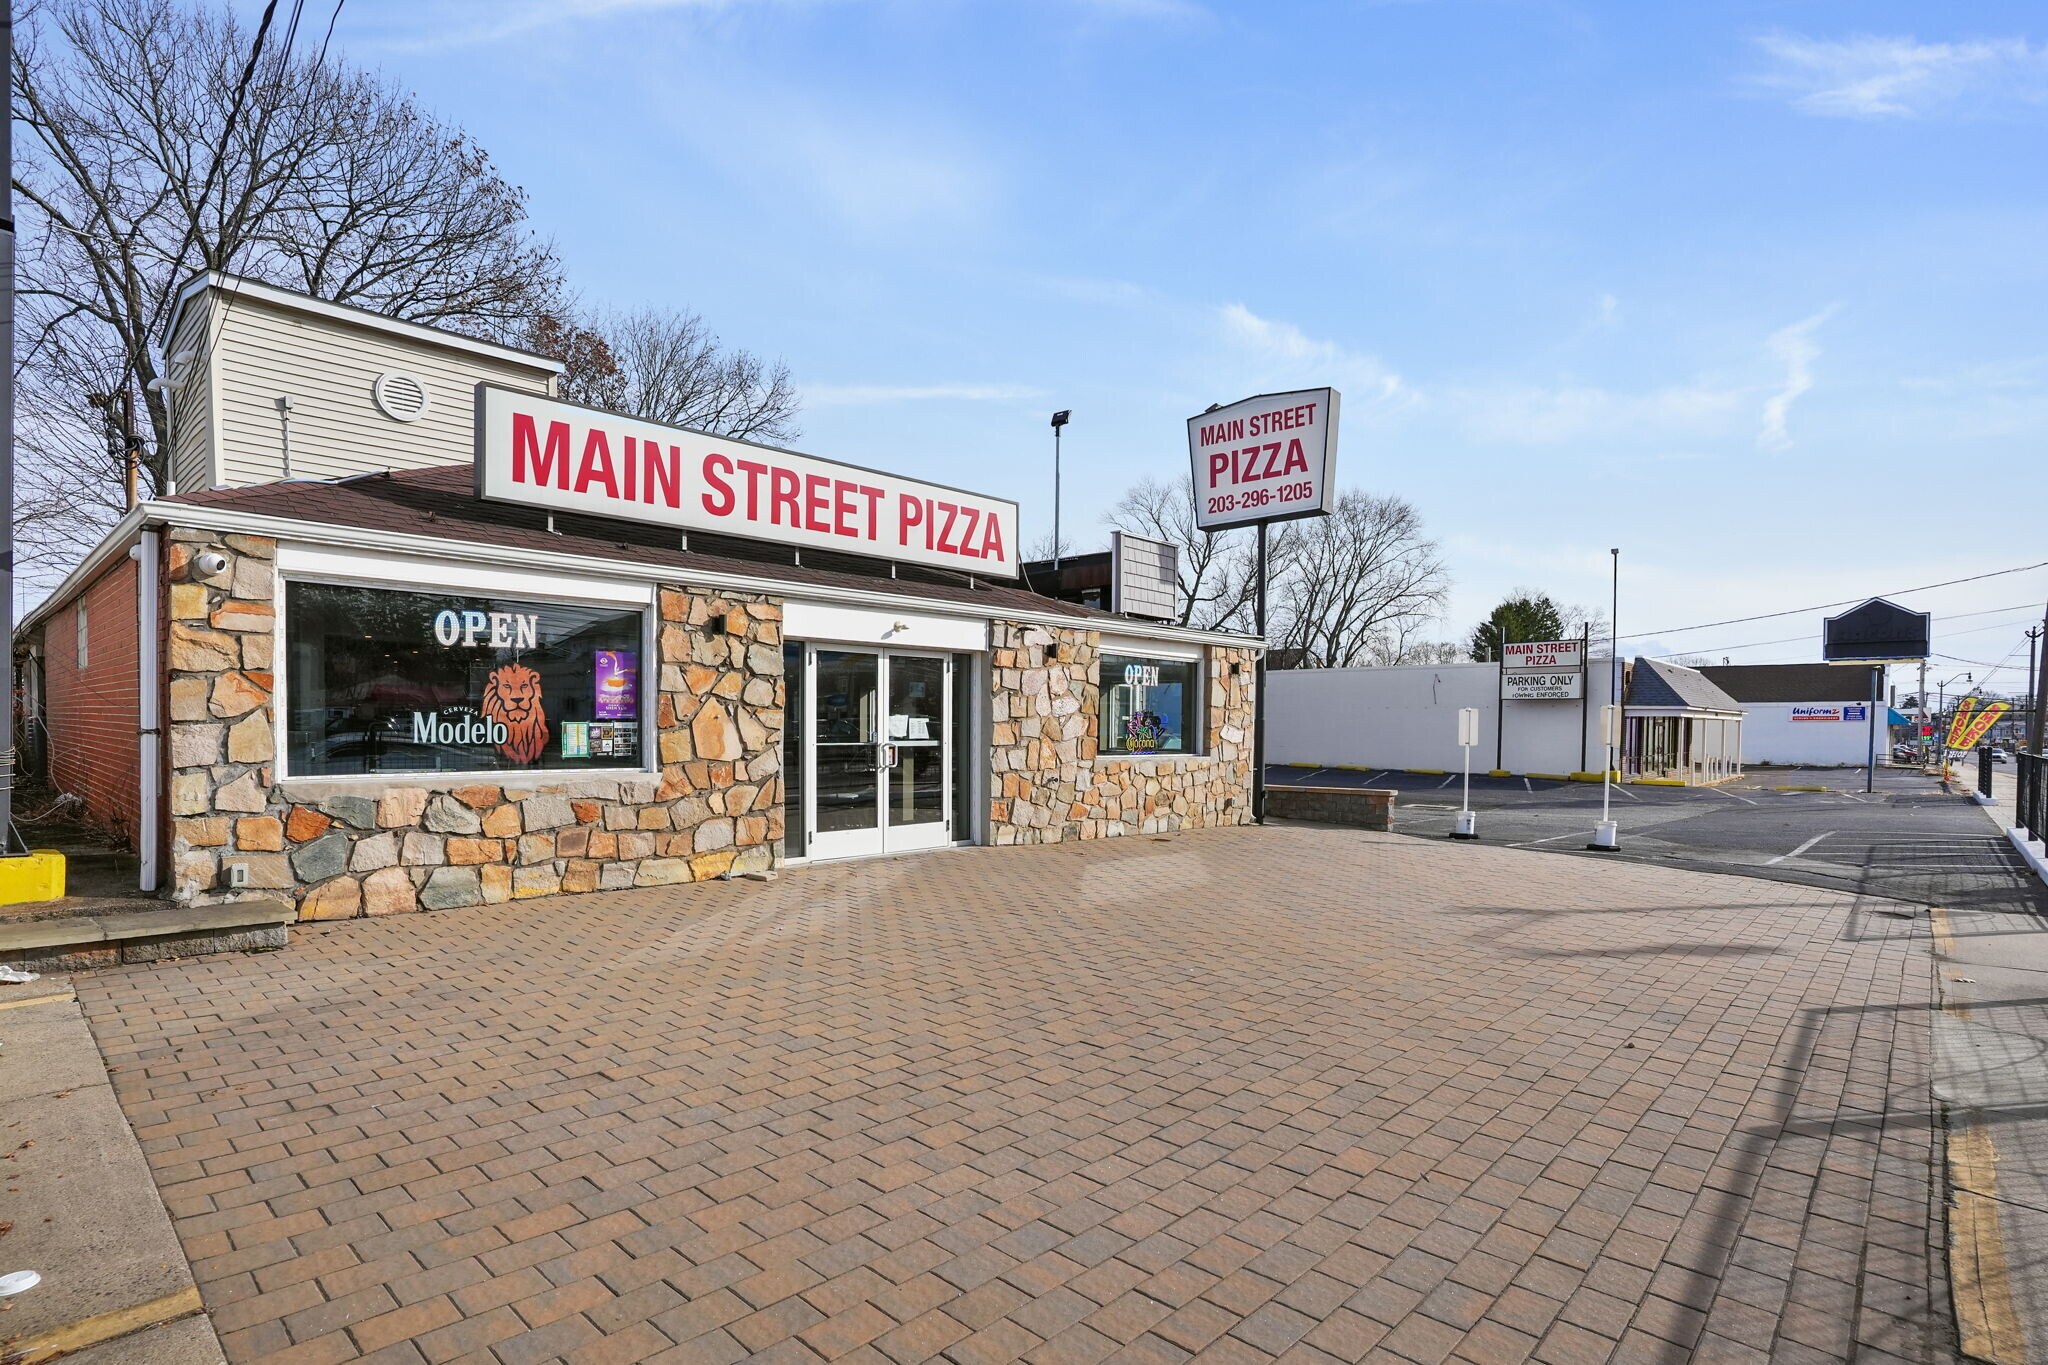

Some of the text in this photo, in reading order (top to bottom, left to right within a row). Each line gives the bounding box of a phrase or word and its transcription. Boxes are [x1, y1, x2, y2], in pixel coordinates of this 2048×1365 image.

[1200, 403, 1317, 447] MAIN STREET
[1209, 438, 1309, 489] PIZZA
[512, 412, 1005, 562] MAIN STREET PIZZA
[1208, 481, 1313, 515] 203-296-1205
[434, 610, 539, 649] OPEN
[1505, 642, 1579, 655] MAIN STREET
[1525, 655, 1557, 666] PIZZA
[1124, 664, 1160, 687] OPEN
[1507, 675, 1574, 687] PARKING ONLY
[443, 706, 479, 716] CERVEZA
[413, 711, 508, 744] Modelo
[1126, 737, 1155, 752] Corona
